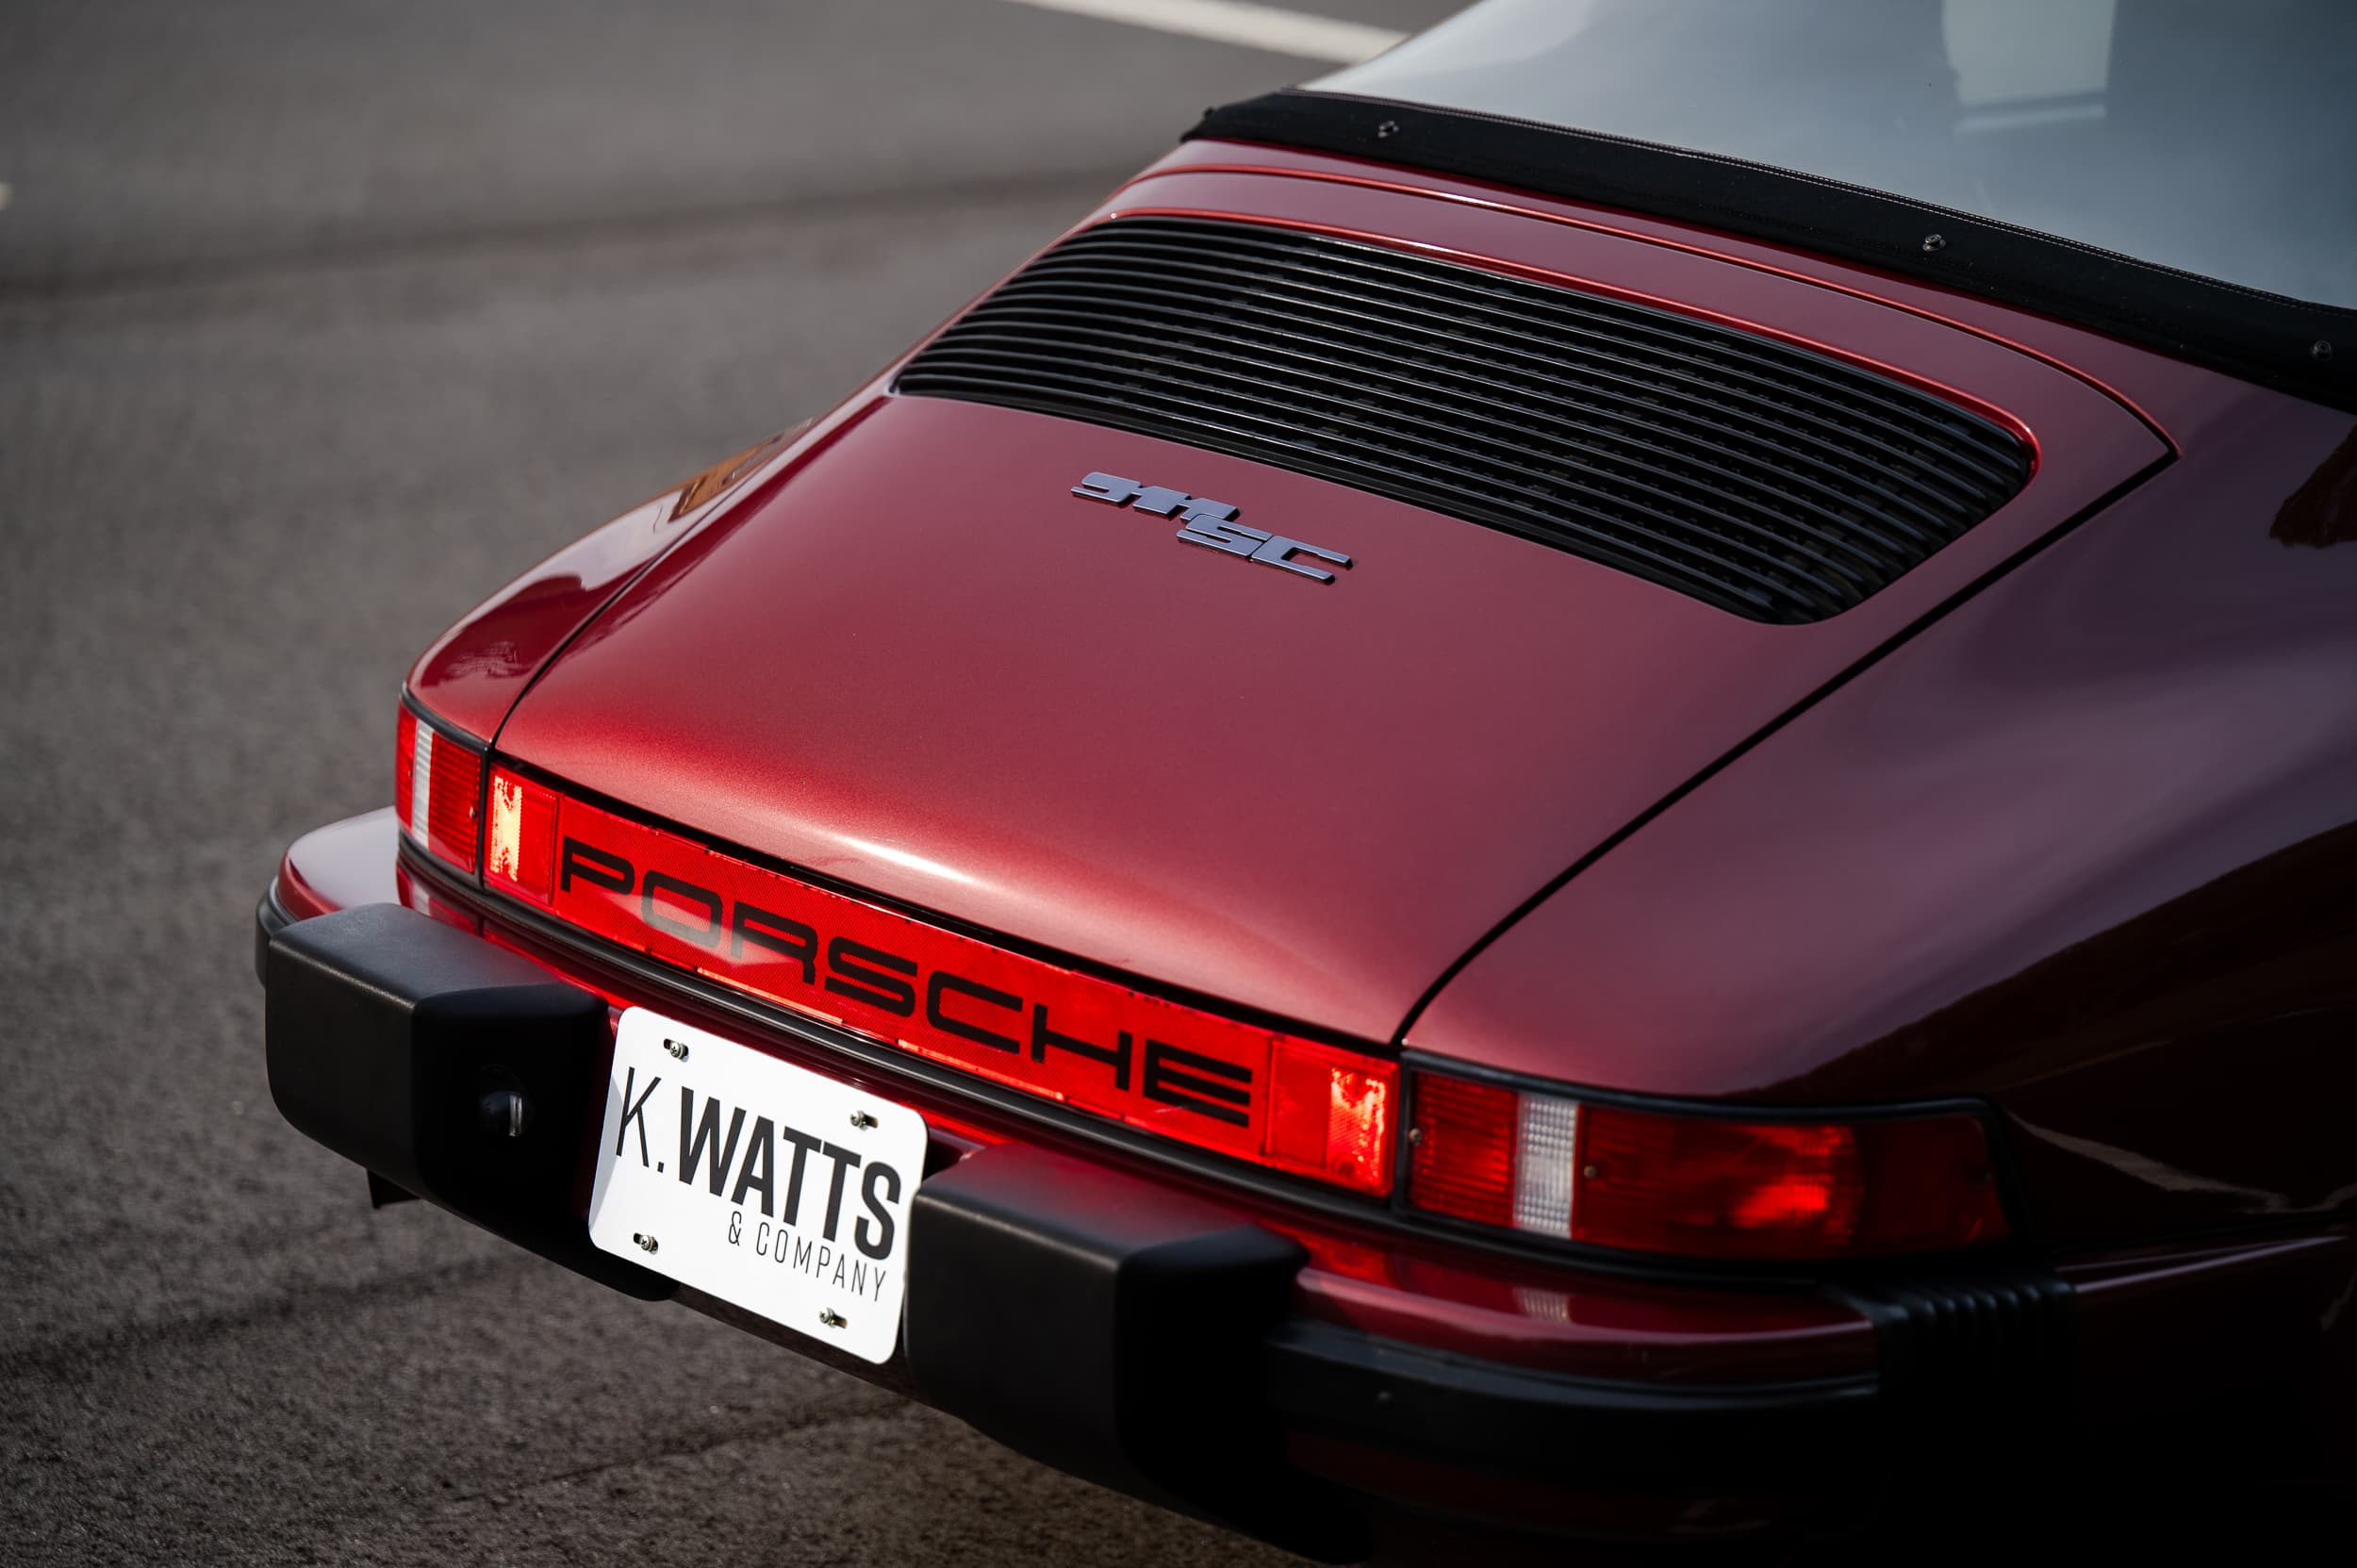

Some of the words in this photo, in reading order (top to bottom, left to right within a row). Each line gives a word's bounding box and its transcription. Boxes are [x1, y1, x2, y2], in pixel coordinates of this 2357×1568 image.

[560, 835, 1252, 1128] PORSCHE
[728, 1211, 742, 1246] &
[755, 1221, 886, 1302] COMPANY
